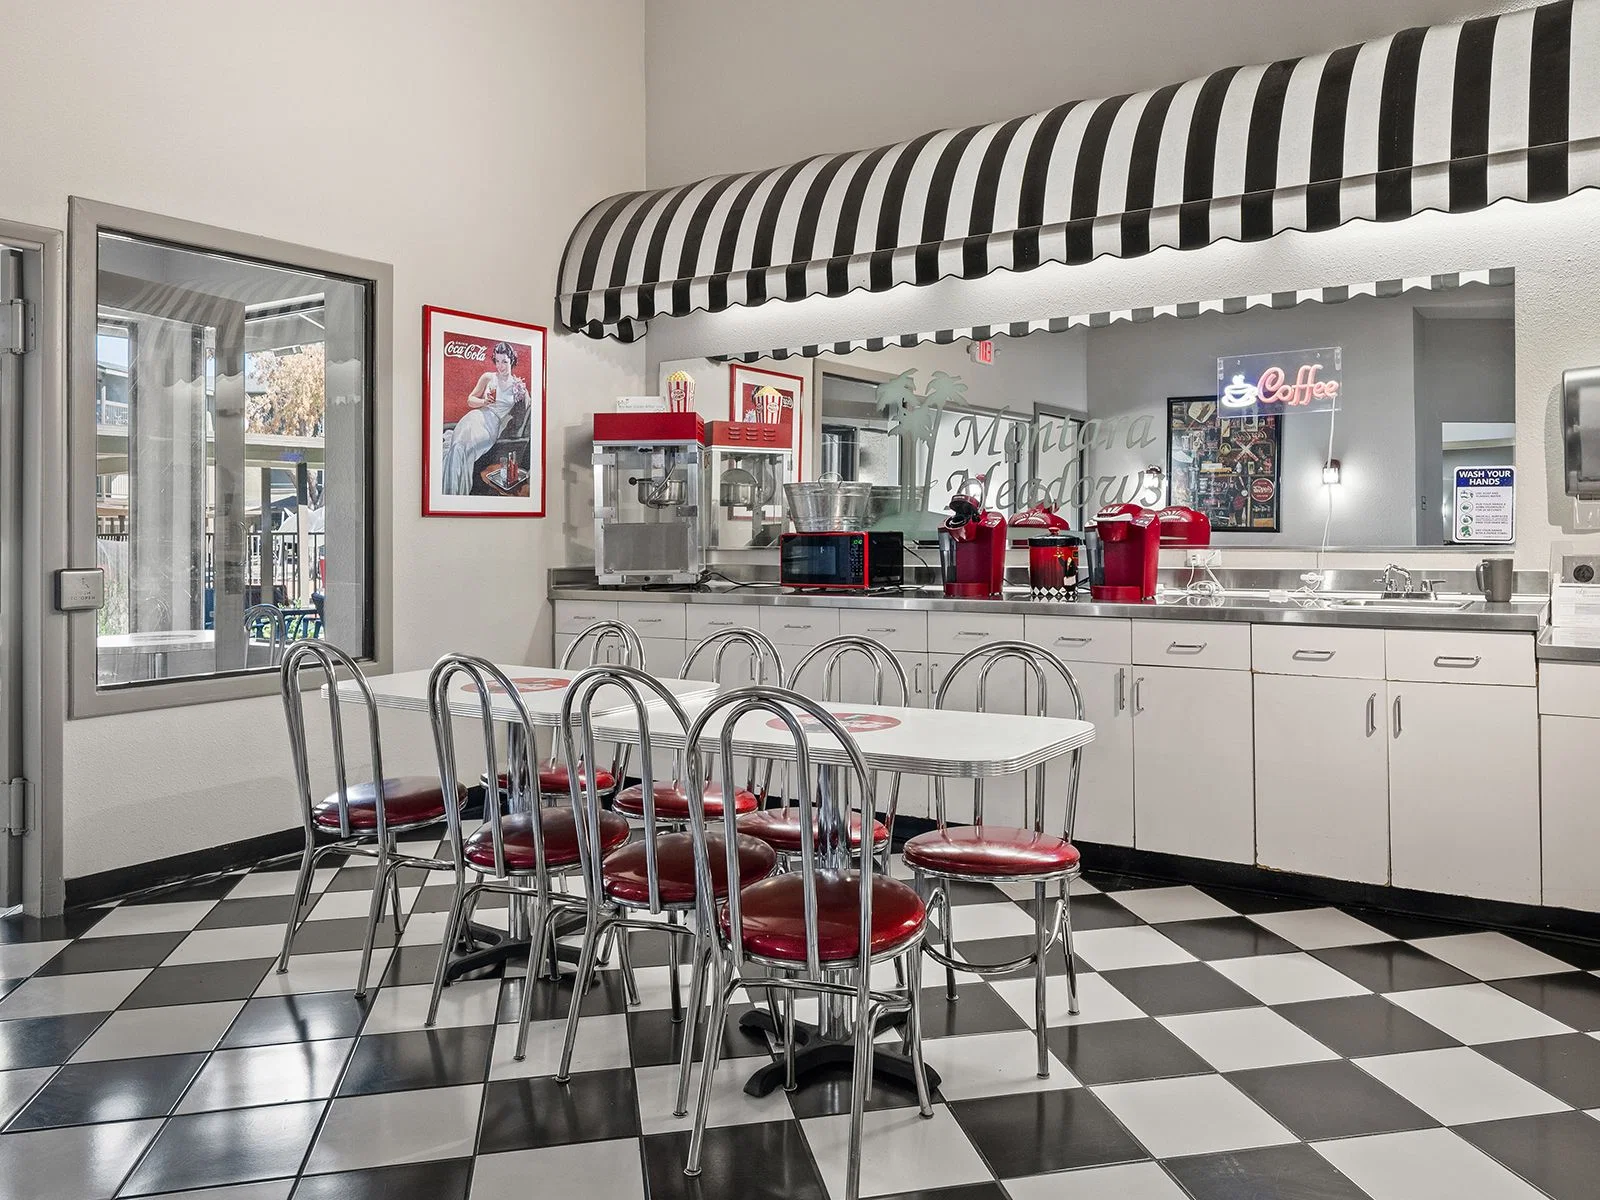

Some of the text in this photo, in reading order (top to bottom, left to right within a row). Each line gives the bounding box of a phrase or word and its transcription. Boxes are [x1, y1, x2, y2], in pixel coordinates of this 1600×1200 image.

[445, 341, 487, 361] Coca-Cola
[1257, 364, 1339, 406] Coffee
[951, 405, 1157, 457] Montara
[944, 457, 1165, 511] Meadows
[1459, 470, 1511, 478] WASH YOUR
[1469, 478, 1500, 486] HANDS
